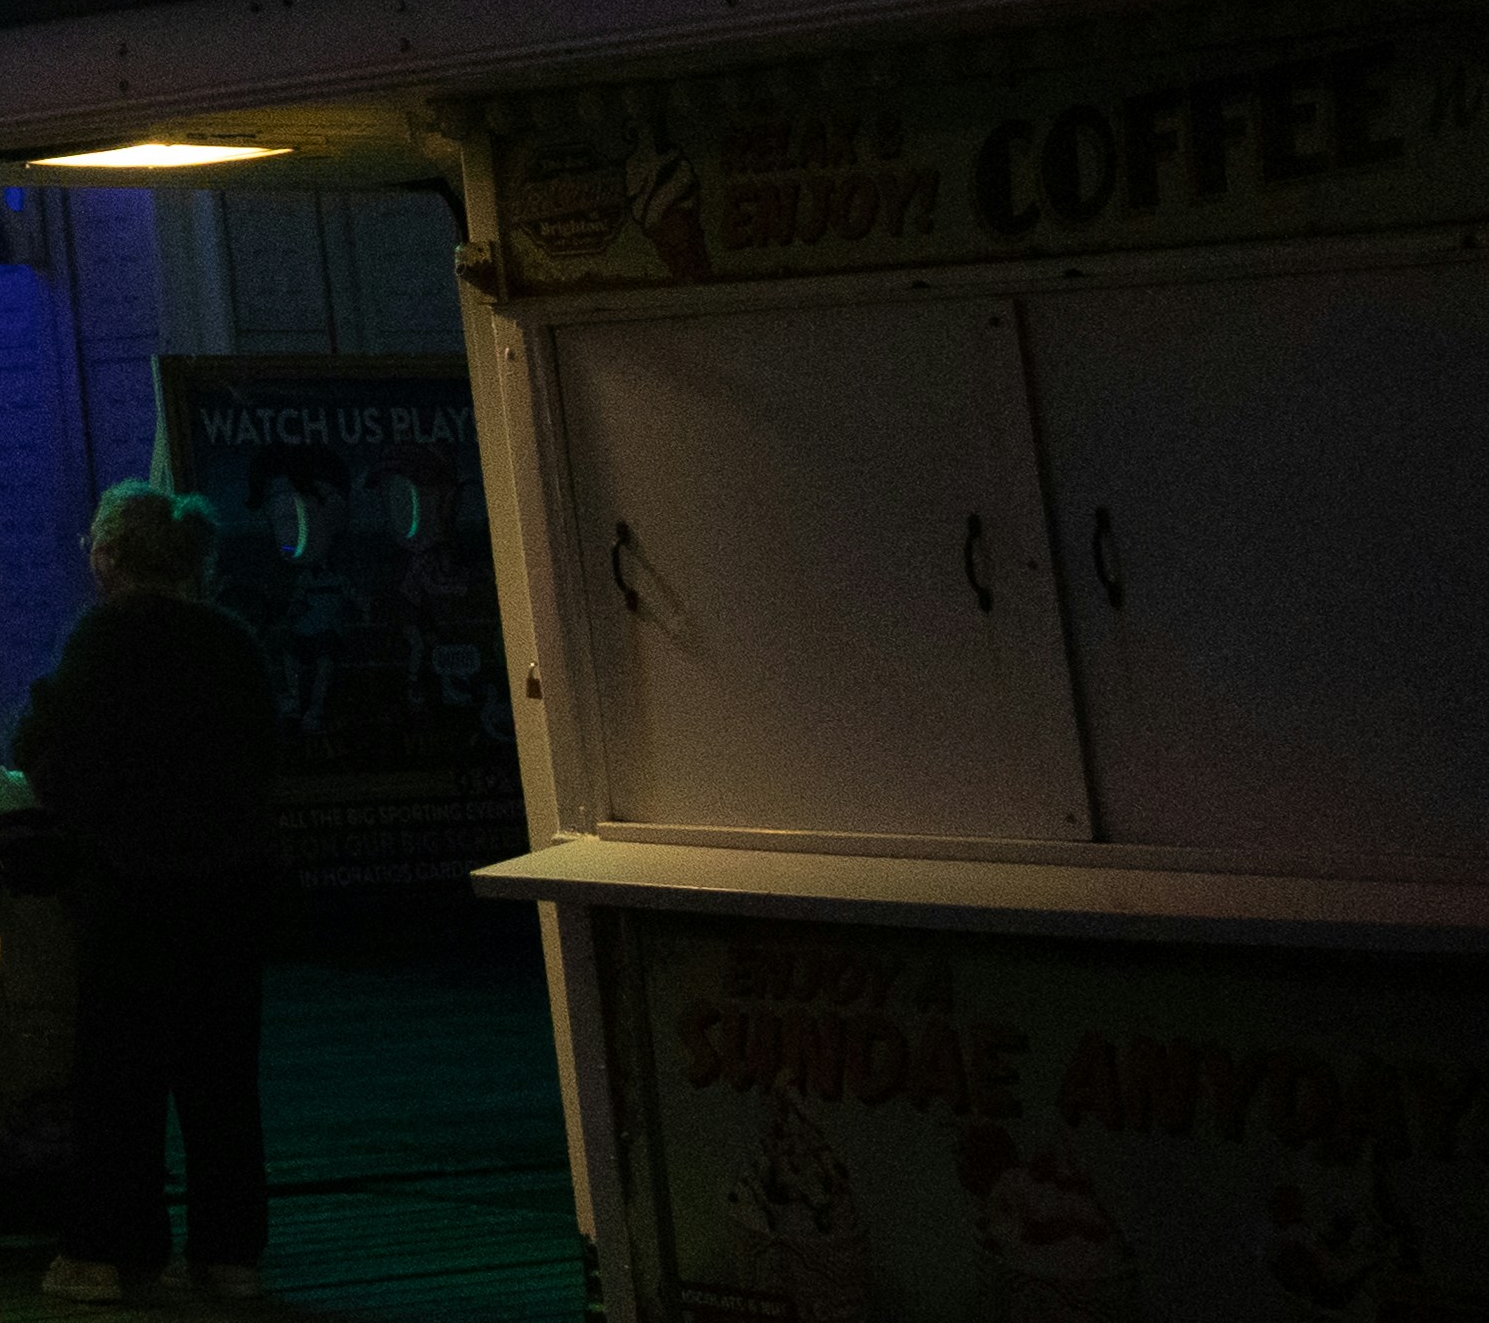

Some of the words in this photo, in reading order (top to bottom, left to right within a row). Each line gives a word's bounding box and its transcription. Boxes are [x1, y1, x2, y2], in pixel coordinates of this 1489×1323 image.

[973, 40, 1405, 237] COFFEE
[198, 408, 331, 446] WATCH
[337, 407, 384, 444] US
[389, 406, 471, 444] PLAY
[725, 947, 900, 1008] ENJOY
[677, 998, 1030, 1120] SUNDAE
